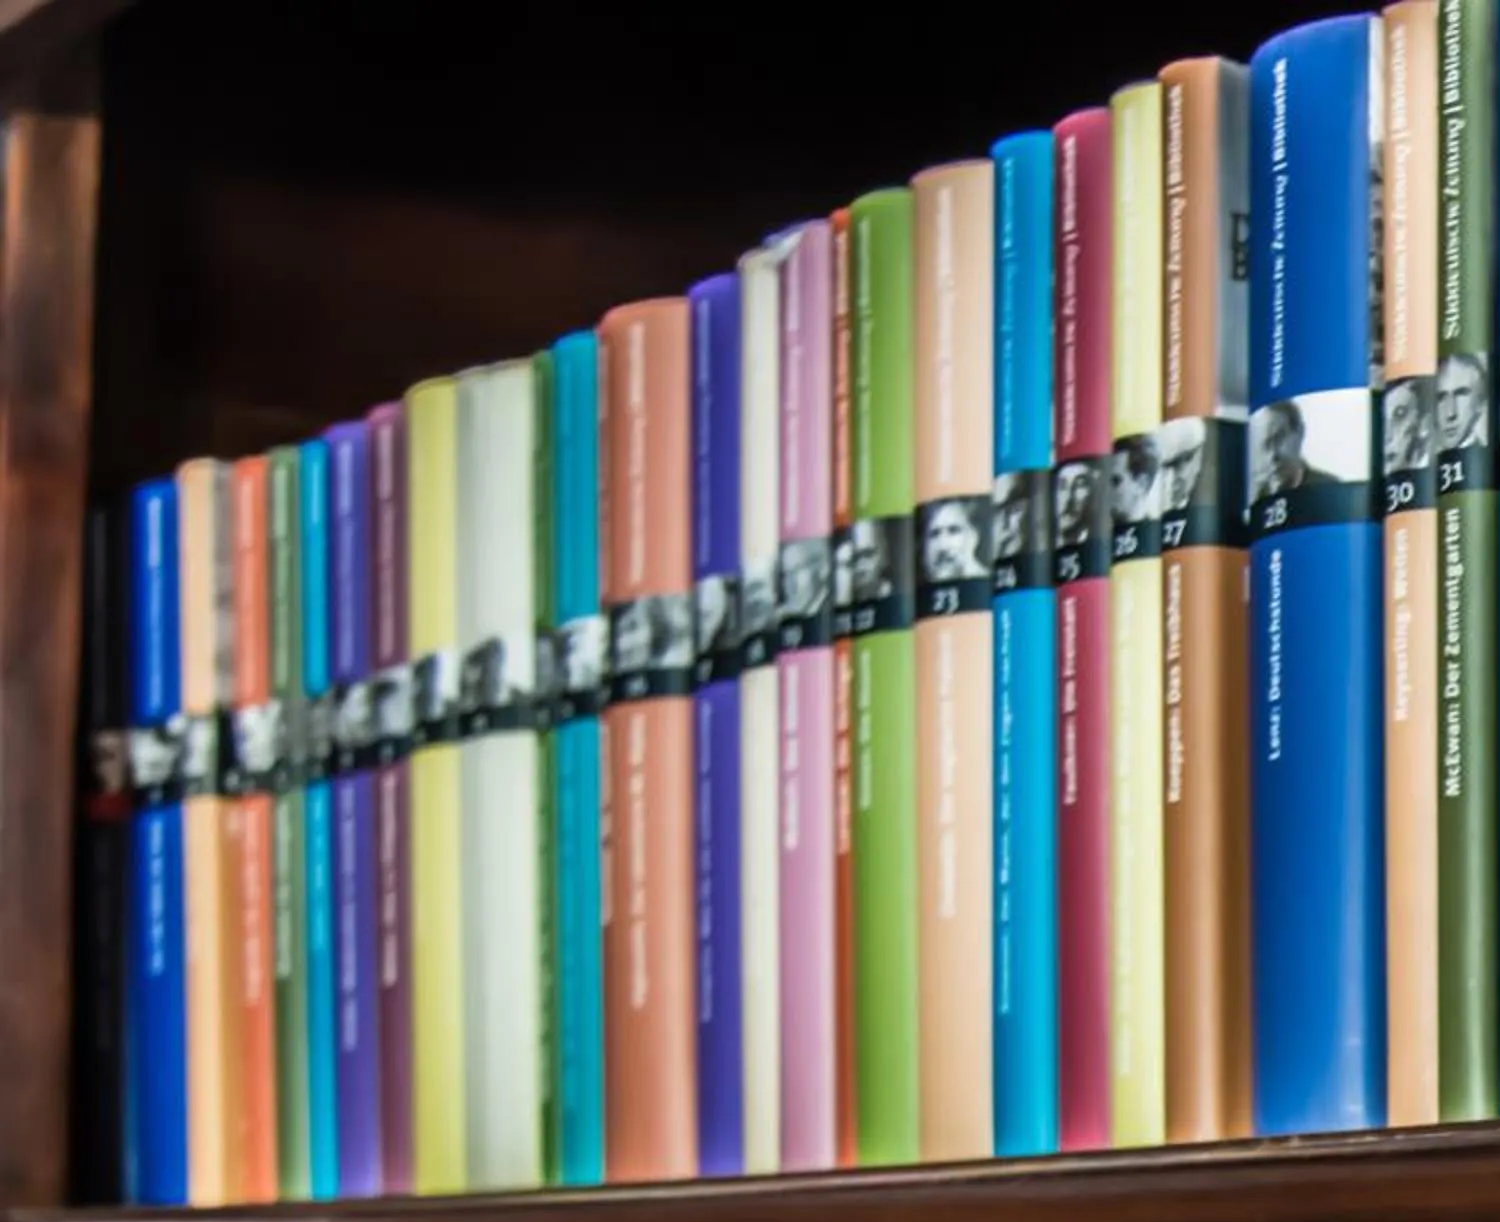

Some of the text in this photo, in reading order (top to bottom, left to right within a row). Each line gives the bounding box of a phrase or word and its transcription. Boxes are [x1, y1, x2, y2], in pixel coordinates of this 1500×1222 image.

[1273, 57, 1287, 162] Bibliothek
[1386, 480, 1414, 511] 30
[1440, 461, 1465, 491] 31
[1444, 507, 1464, 796] McEwan: Der Zementgarten
